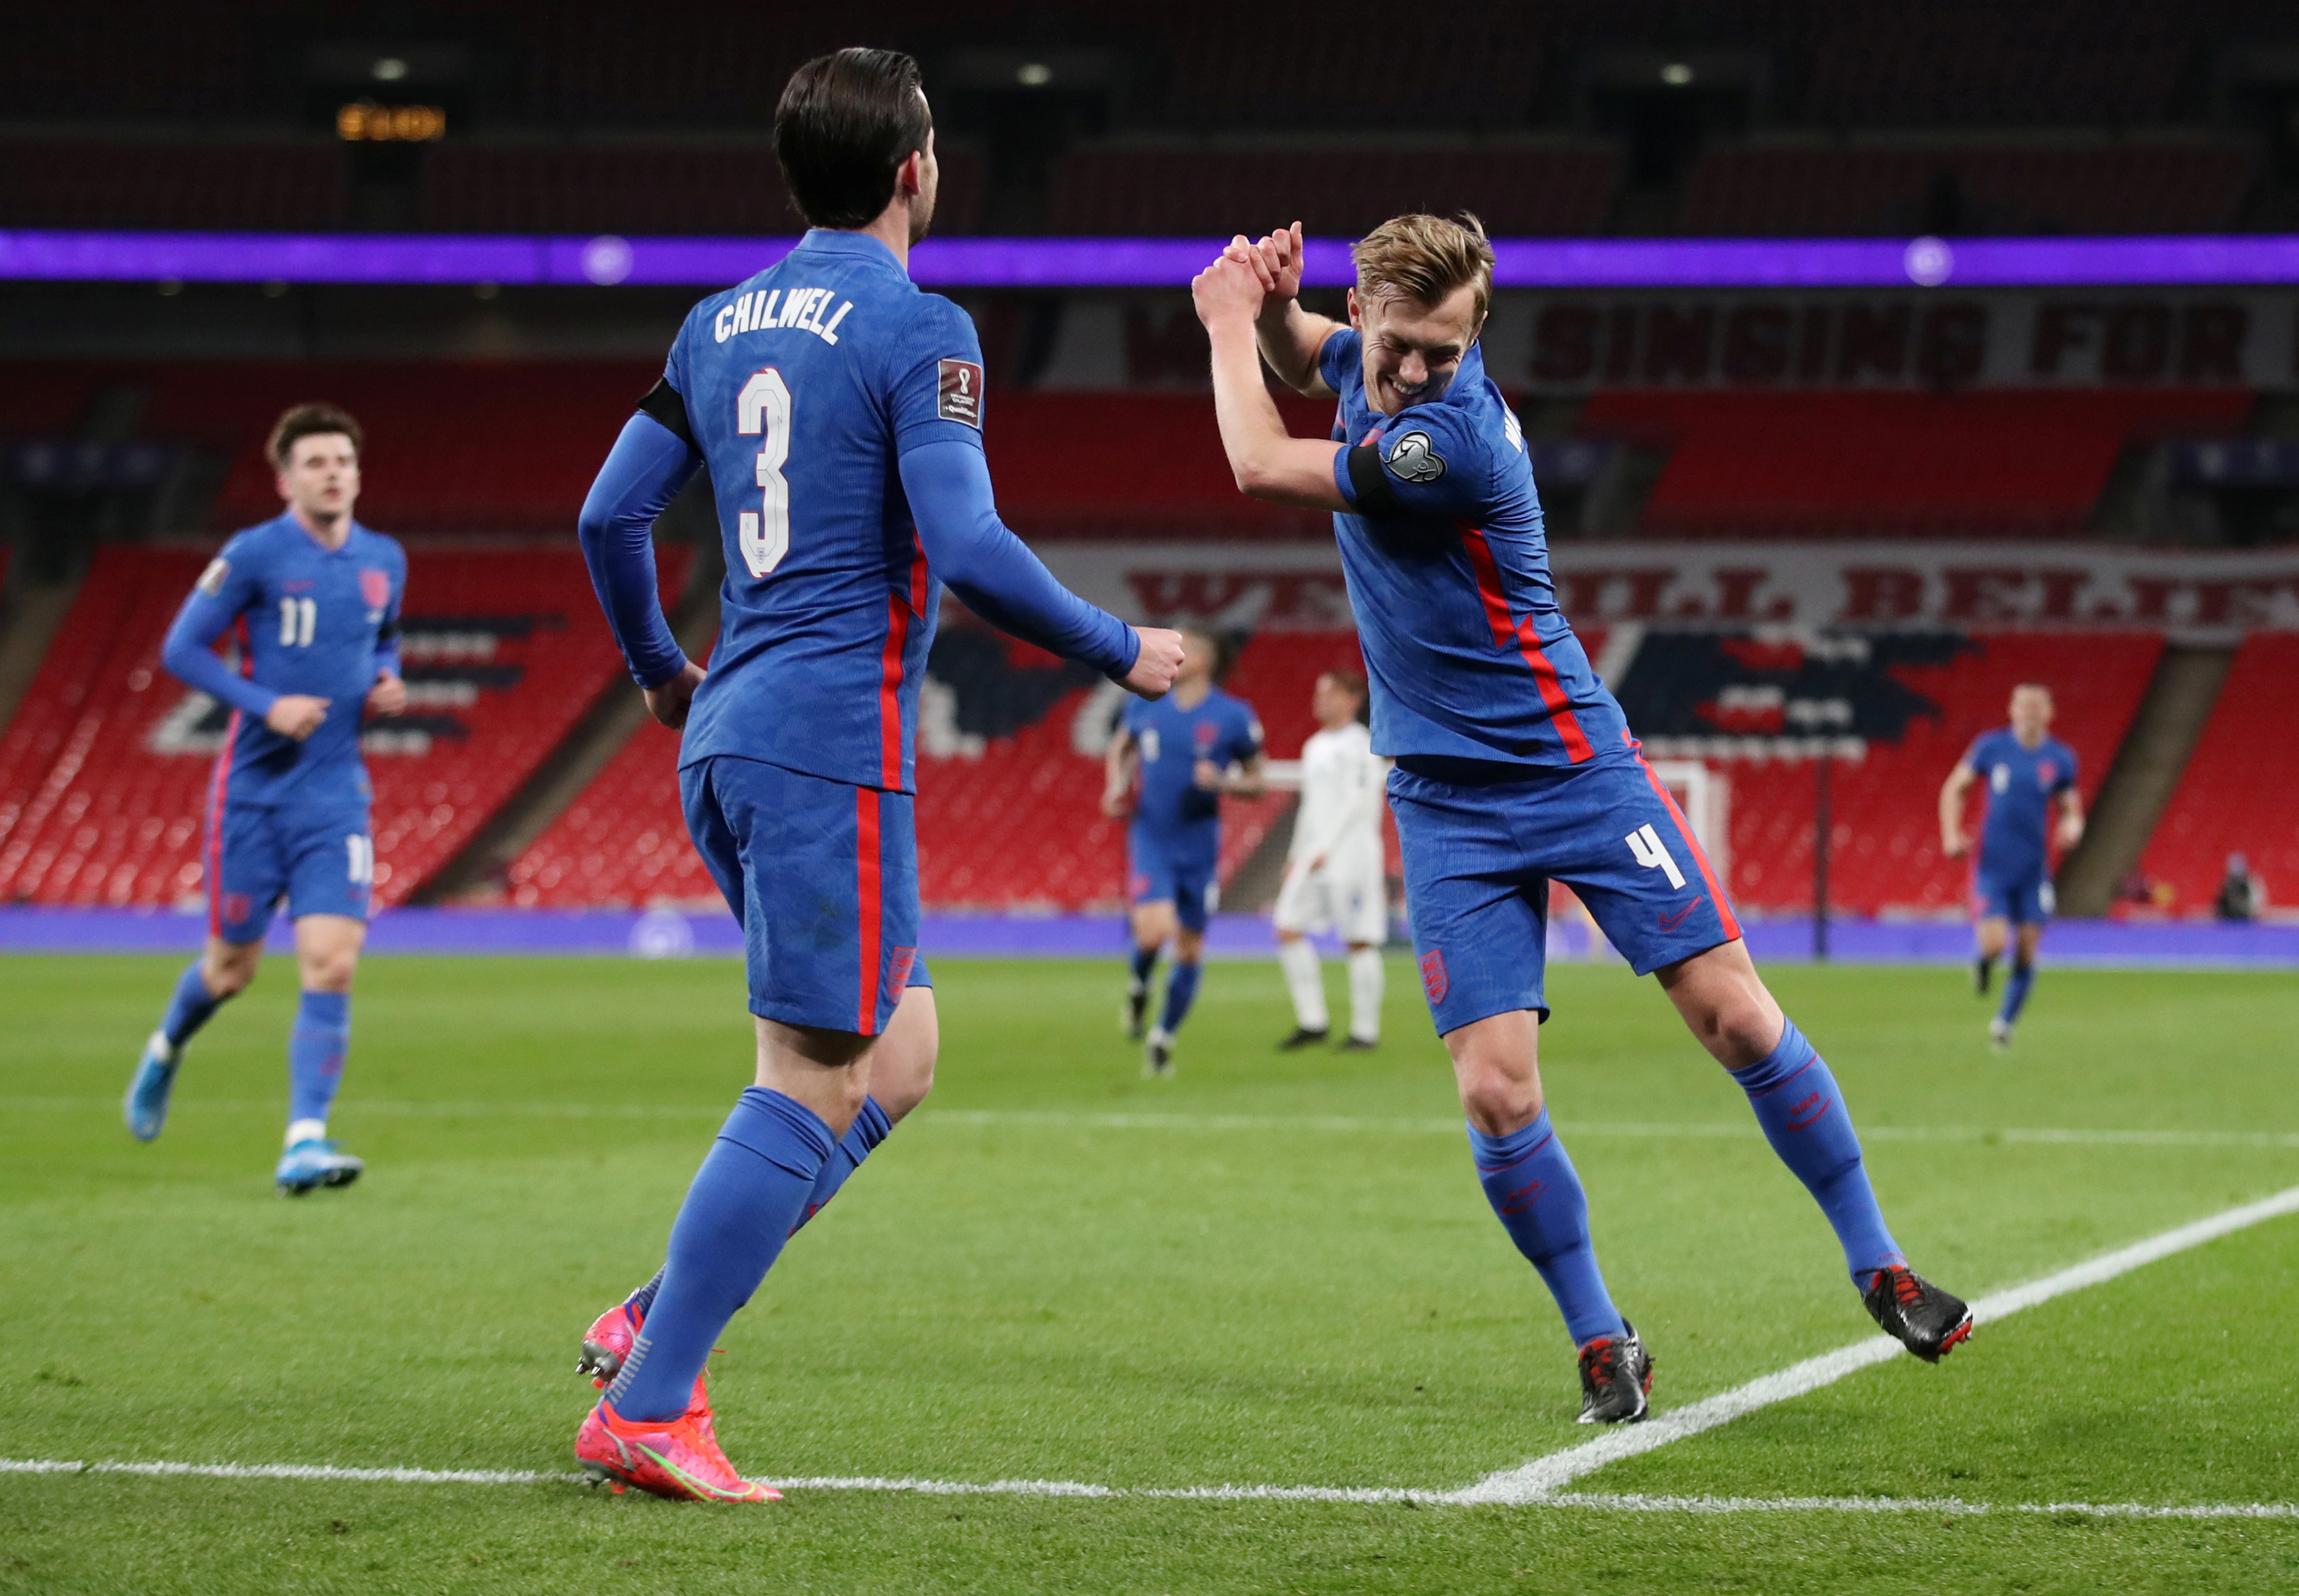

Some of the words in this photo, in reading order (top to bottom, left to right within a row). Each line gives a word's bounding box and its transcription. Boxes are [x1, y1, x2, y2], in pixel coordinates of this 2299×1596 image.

[715, 286, 854, 346] CHILWELL
[1530, 303, 1987, 381] SINGING
[2029, 303, 2247, 377] FOR
[737, 366, 791, 578] 3
[279, 597, 317, 648] 11
[1553, 570, 1796, 619] ILL
[1624, 823, 1687, 889] 4
